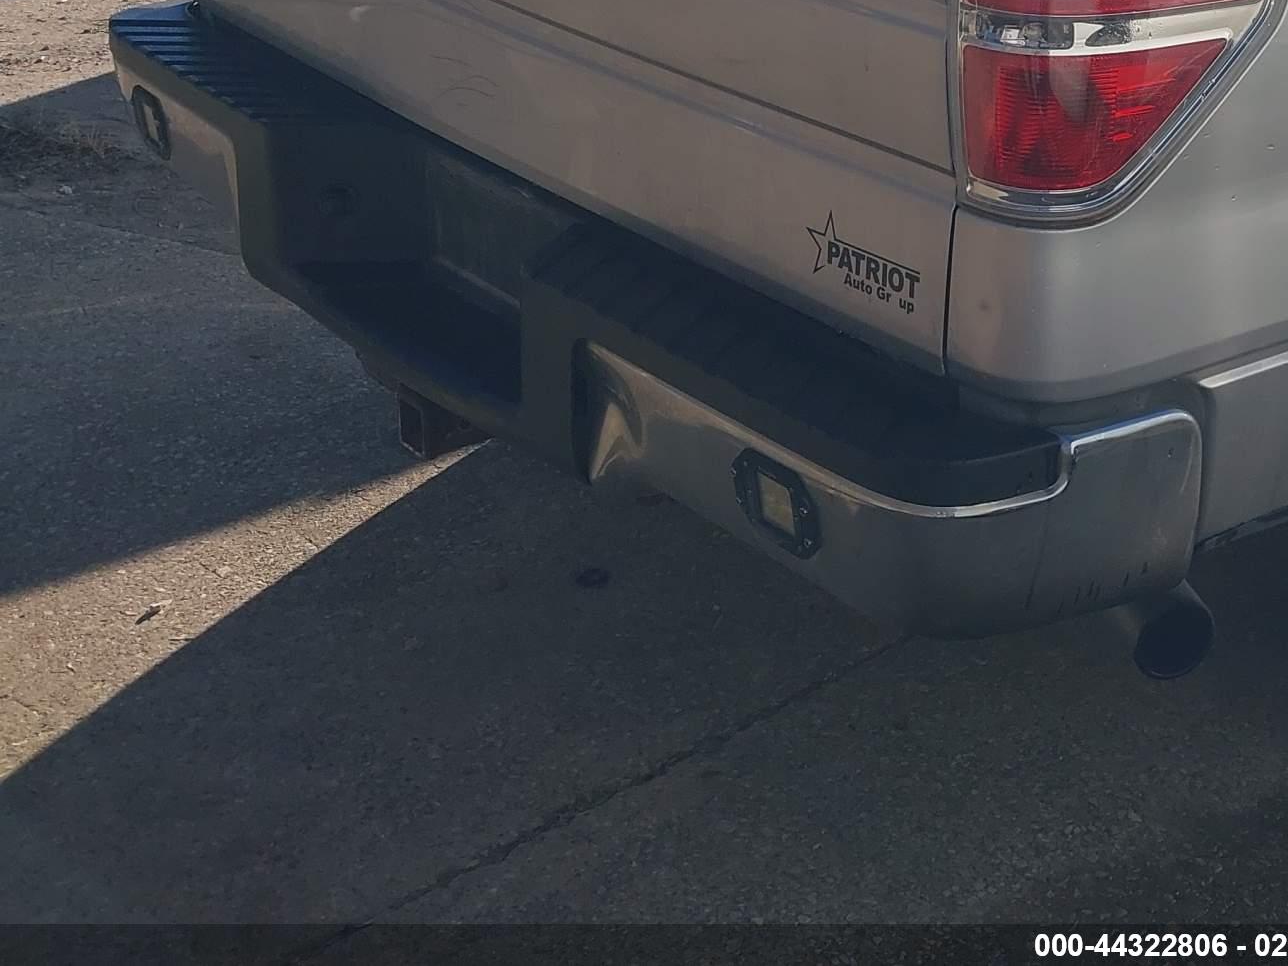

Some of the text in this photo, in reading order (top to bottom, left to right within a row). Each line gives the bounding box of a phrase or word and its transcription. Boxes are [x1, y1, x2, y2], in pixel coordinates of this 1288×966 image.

[827, 241, 920, 298] PATRIOT
[843, 274, 914, 314] Auto Grup
